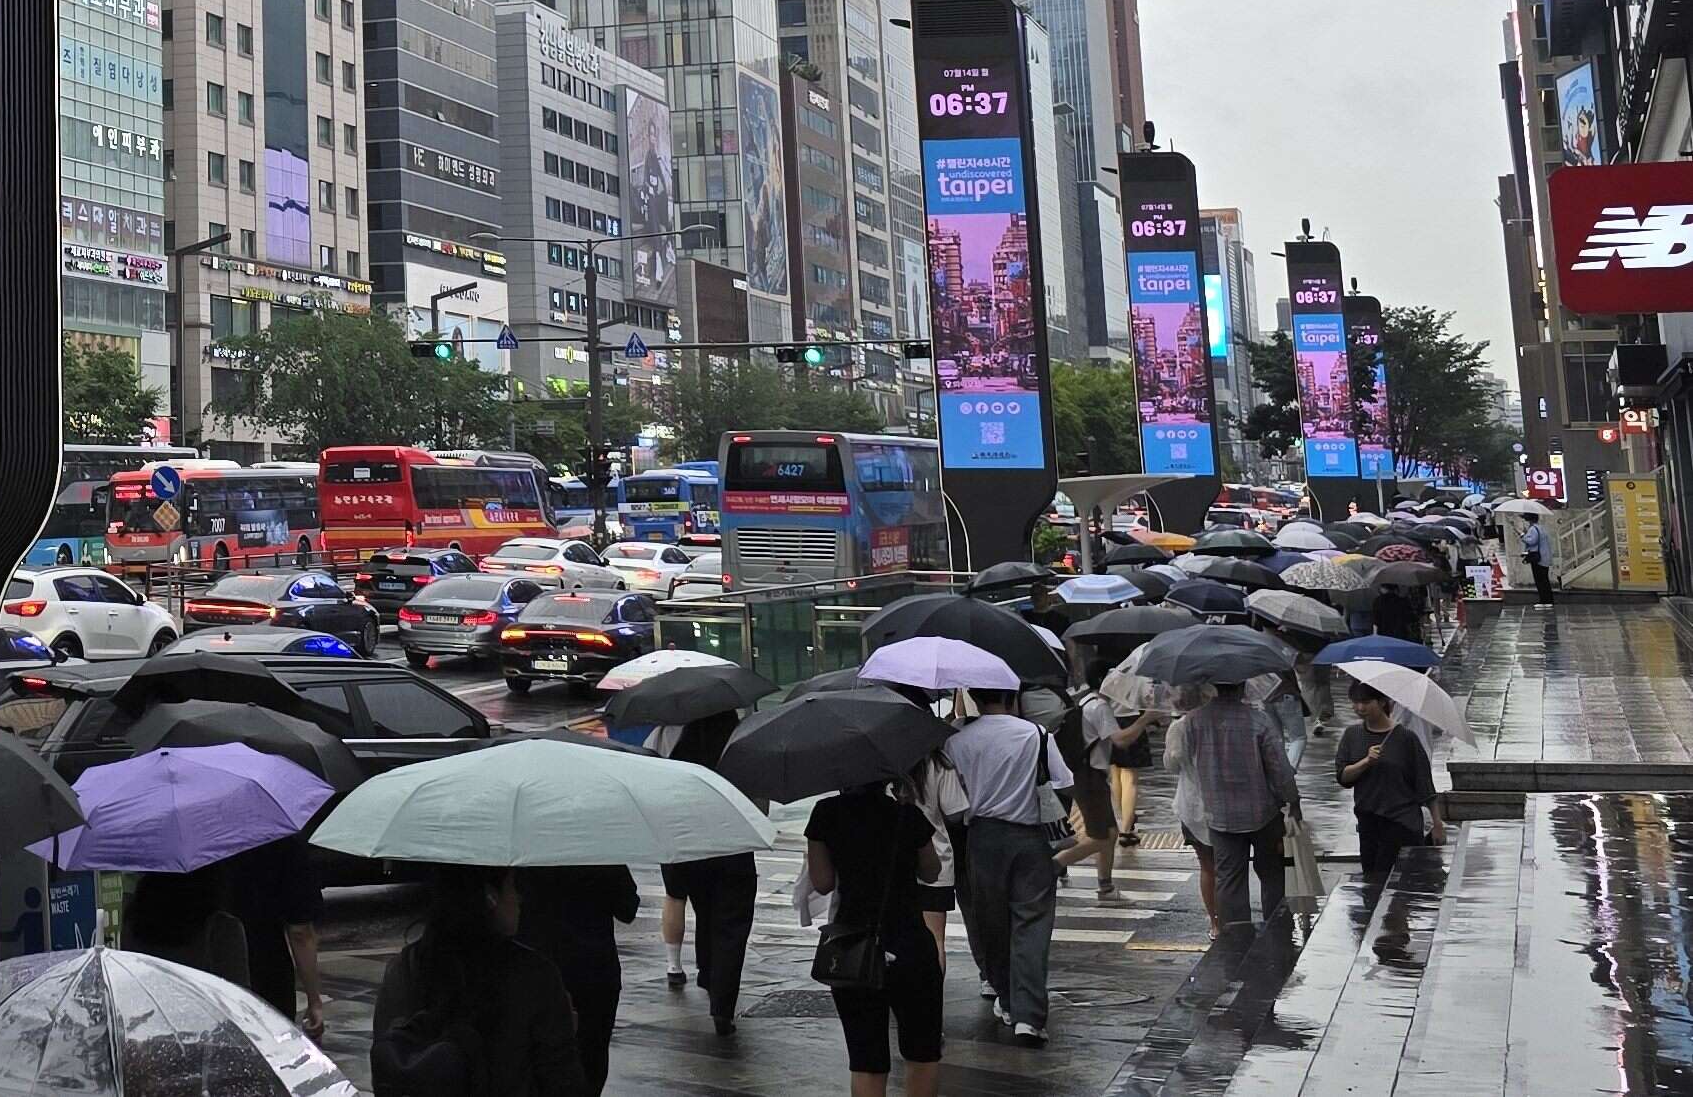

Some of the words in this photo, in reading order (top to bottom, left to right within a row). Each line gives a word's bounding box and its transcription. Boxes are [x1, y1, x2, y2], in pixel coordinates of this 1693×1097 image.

[961, 84, 975, 92] PM
[929, 92, 1008, 116] 06:37
[938, 172, 1014, 202] taipei
[1131, 220, 1187, 237] 06:37
[1138, 275, 1191, 295] taipei
[1295, 291, 1337, 304] 06:37
[1624, 410, 1648, 432] 약
[1532, 470, 1558, 497] 약
